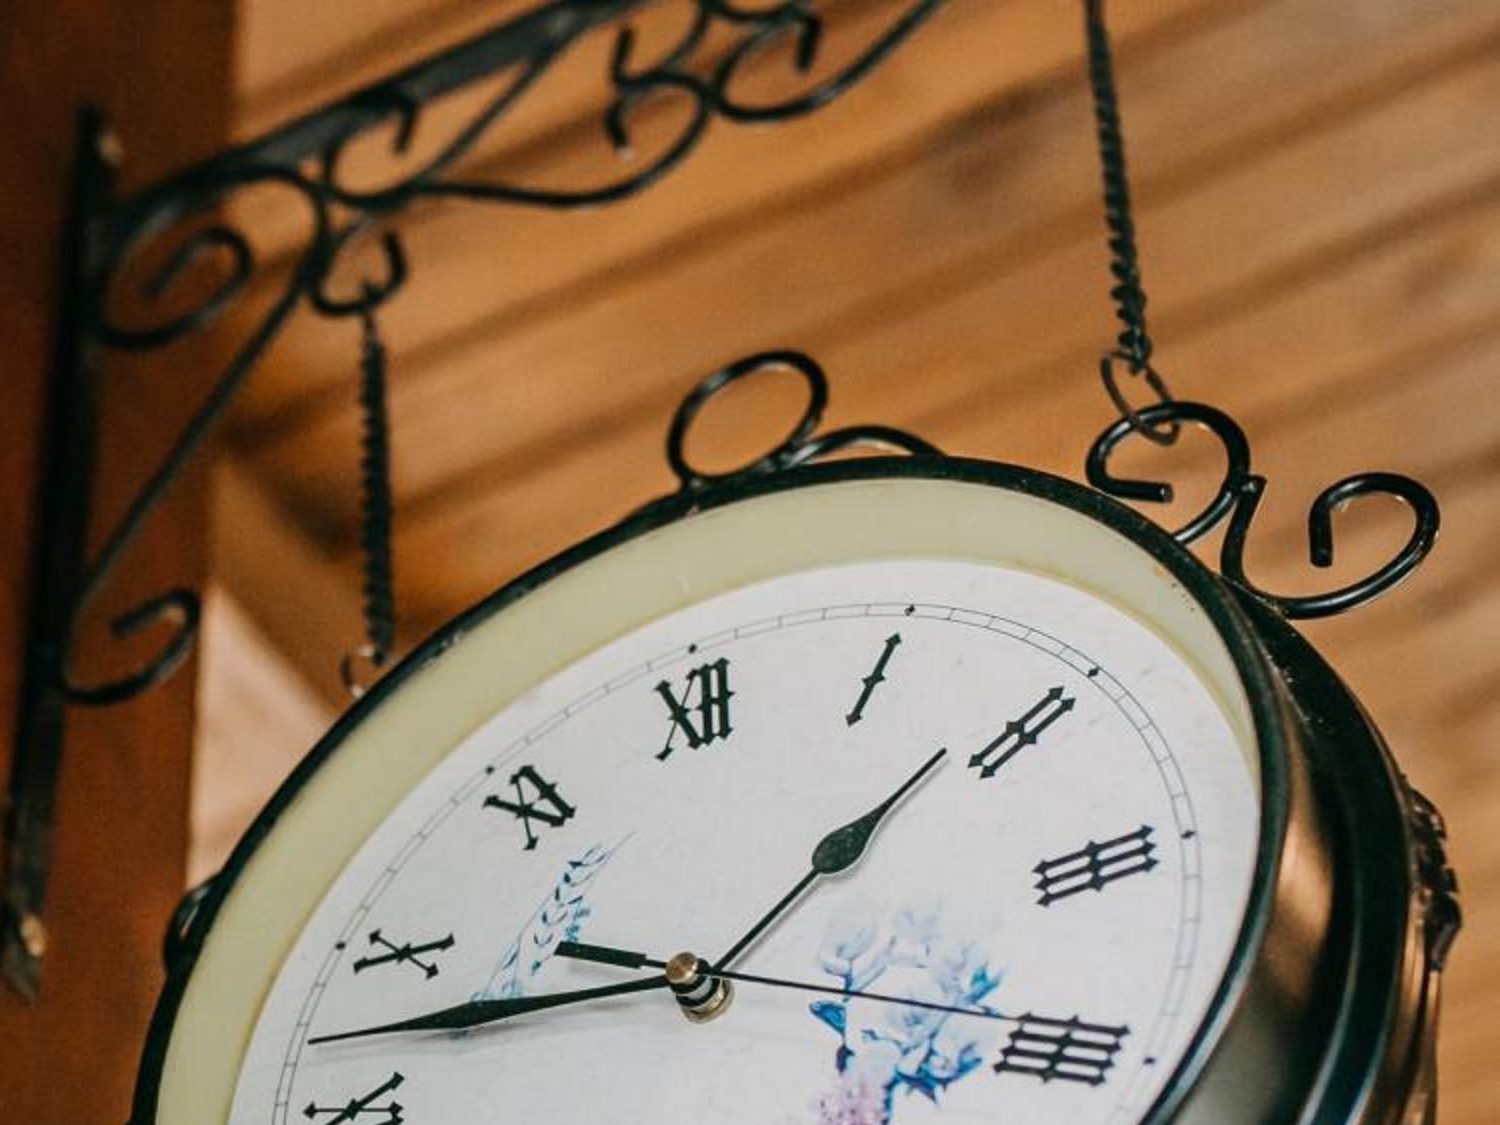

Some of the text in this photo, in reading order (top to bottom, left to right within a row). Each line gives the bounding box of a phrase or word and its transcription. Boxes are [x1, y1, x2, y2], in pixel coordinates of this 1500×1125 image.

[655, 658, 735, 761] XII
[846, 634, 901, 726] I
[968, 687, 1076, 779] II
[485, 765, 576, 850] XI
[1033, 825, 1158, 906] III
[353, 929, 455, 979] X
[993, 1010, 1130, 1086] IIII
